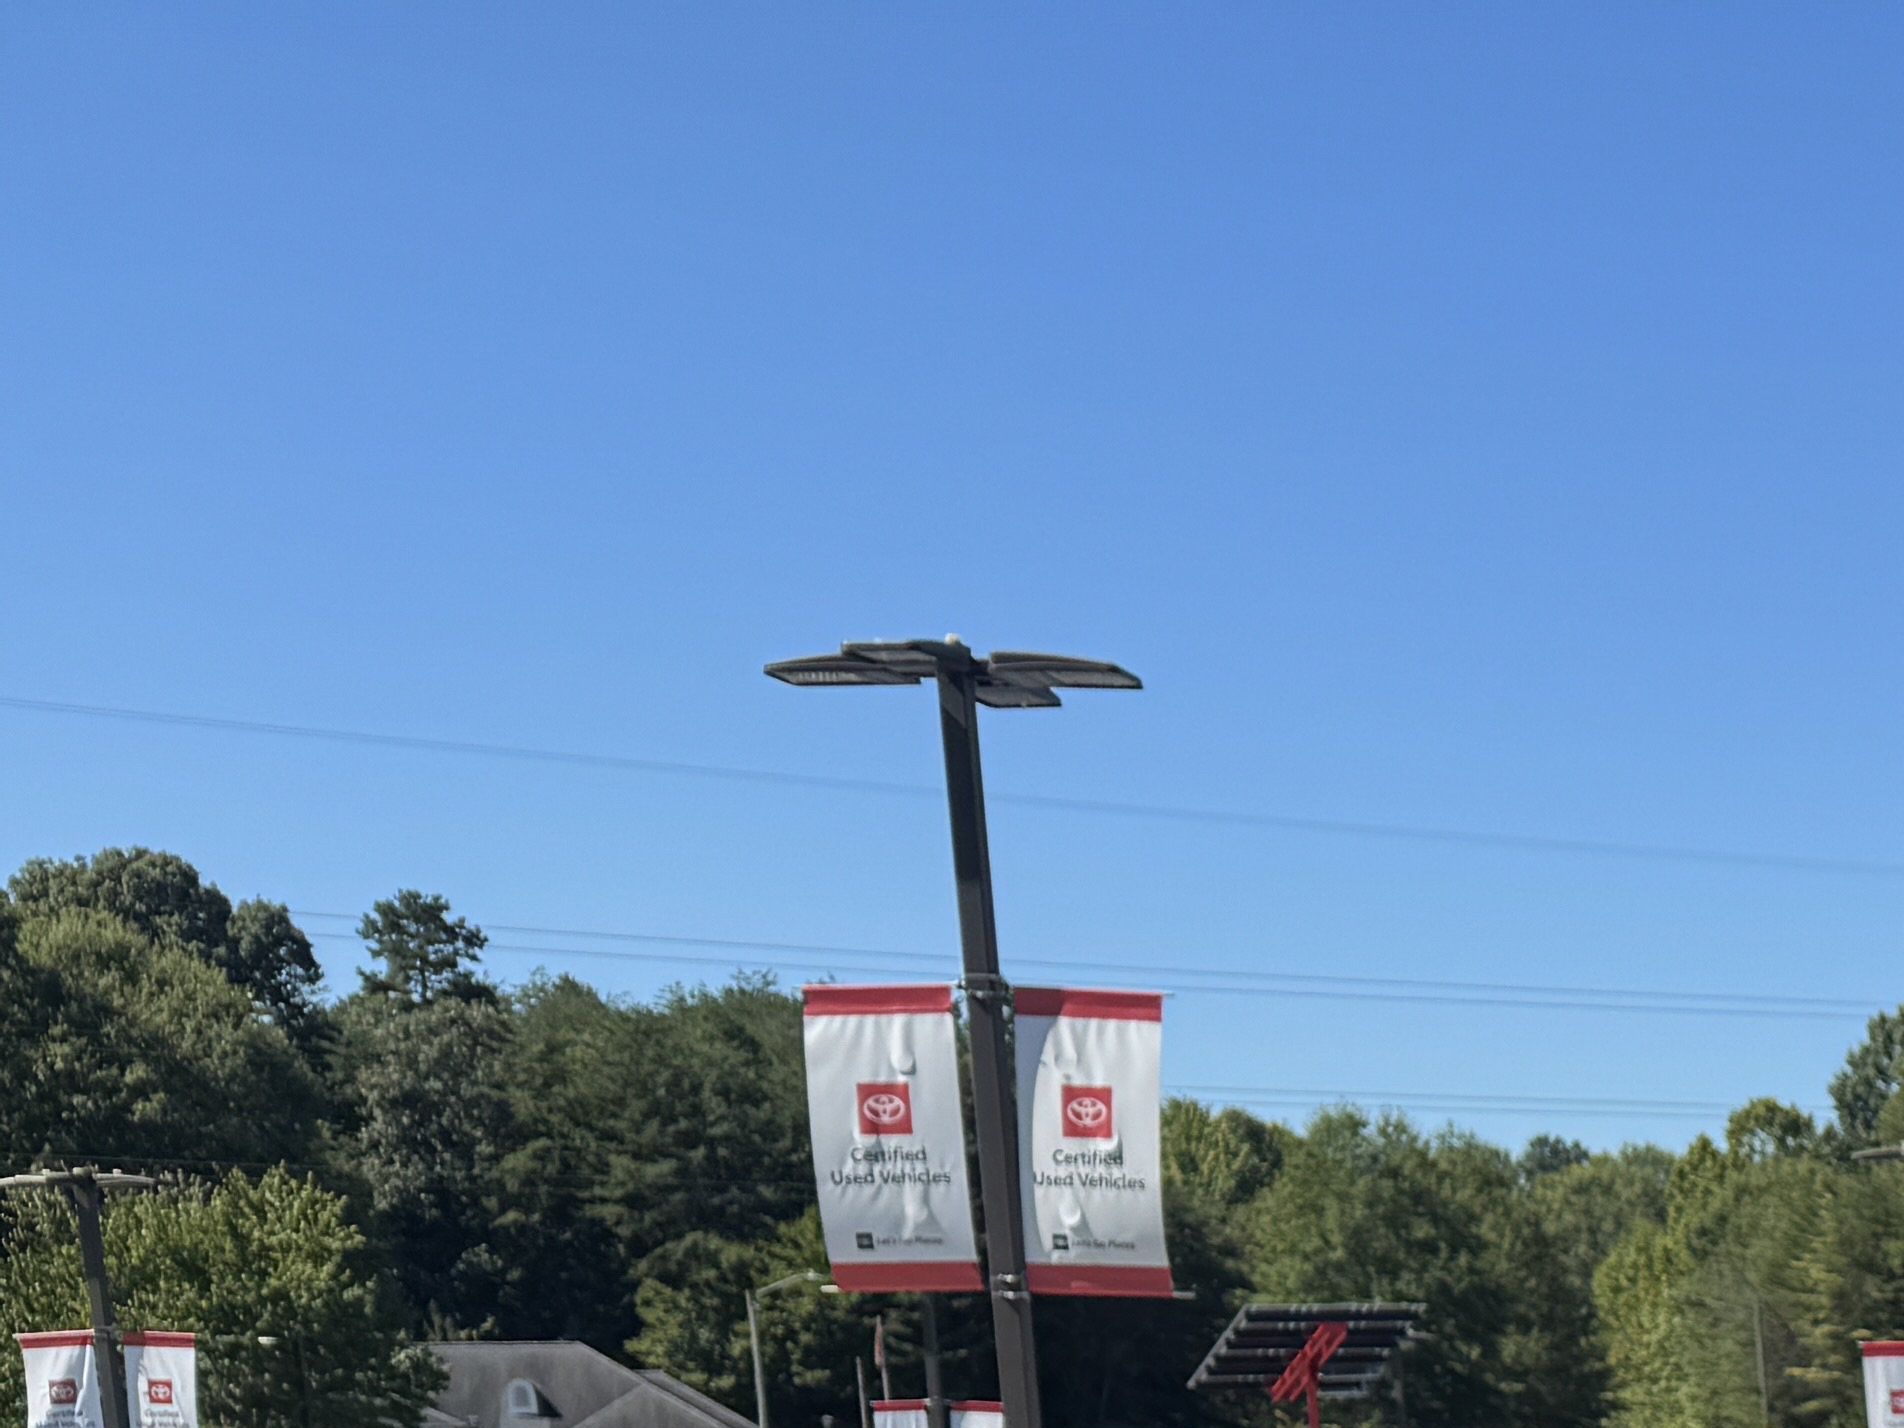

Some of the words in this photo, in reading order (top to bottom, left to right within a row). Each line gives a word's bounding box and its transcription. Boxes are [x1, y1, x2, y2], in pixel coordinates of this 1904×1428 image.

[850, 1144, 928, 1164] Certified
[1052, 1148, 1124, 1167] Certified
[830, 1168, 875, 1186] Used
[879, 1167, 952, 1186] Vehicles
[1033, 1171, 1074, 1187] Used
[1077, 1172, 1146, 1191] Vehicles
